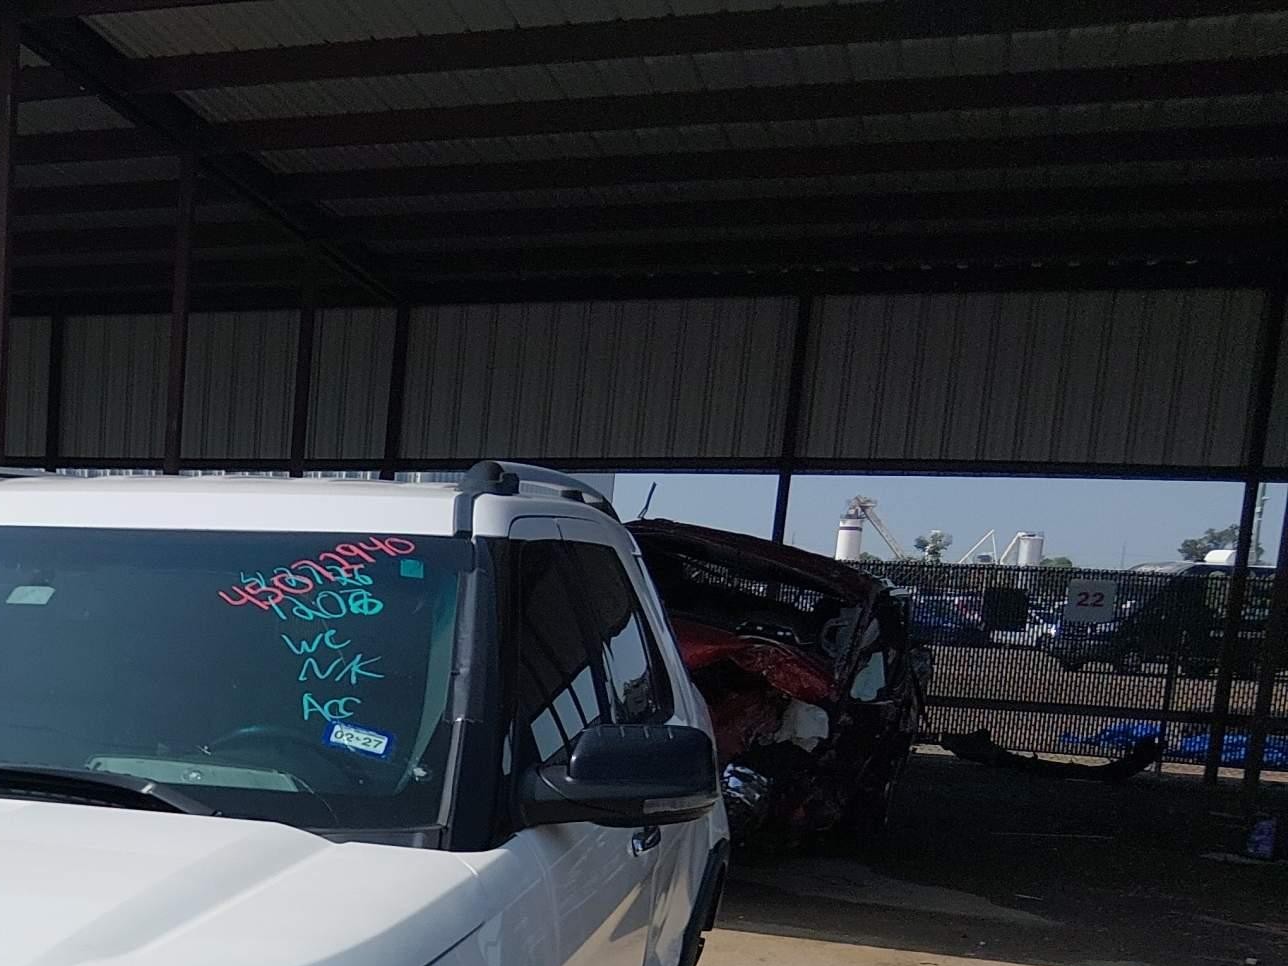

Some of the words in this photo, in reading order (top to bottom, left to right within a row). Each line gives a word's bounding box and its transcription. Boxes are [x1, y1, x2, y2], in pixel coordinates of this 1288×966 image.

[218, 537, 415, 610] 45072940
[1076, 592, 1105, 607] 22
[298, 653, 385, 685] N/K
[302, 693, 361, 722] ACC
[334, 729, 383, 749] 02-27
